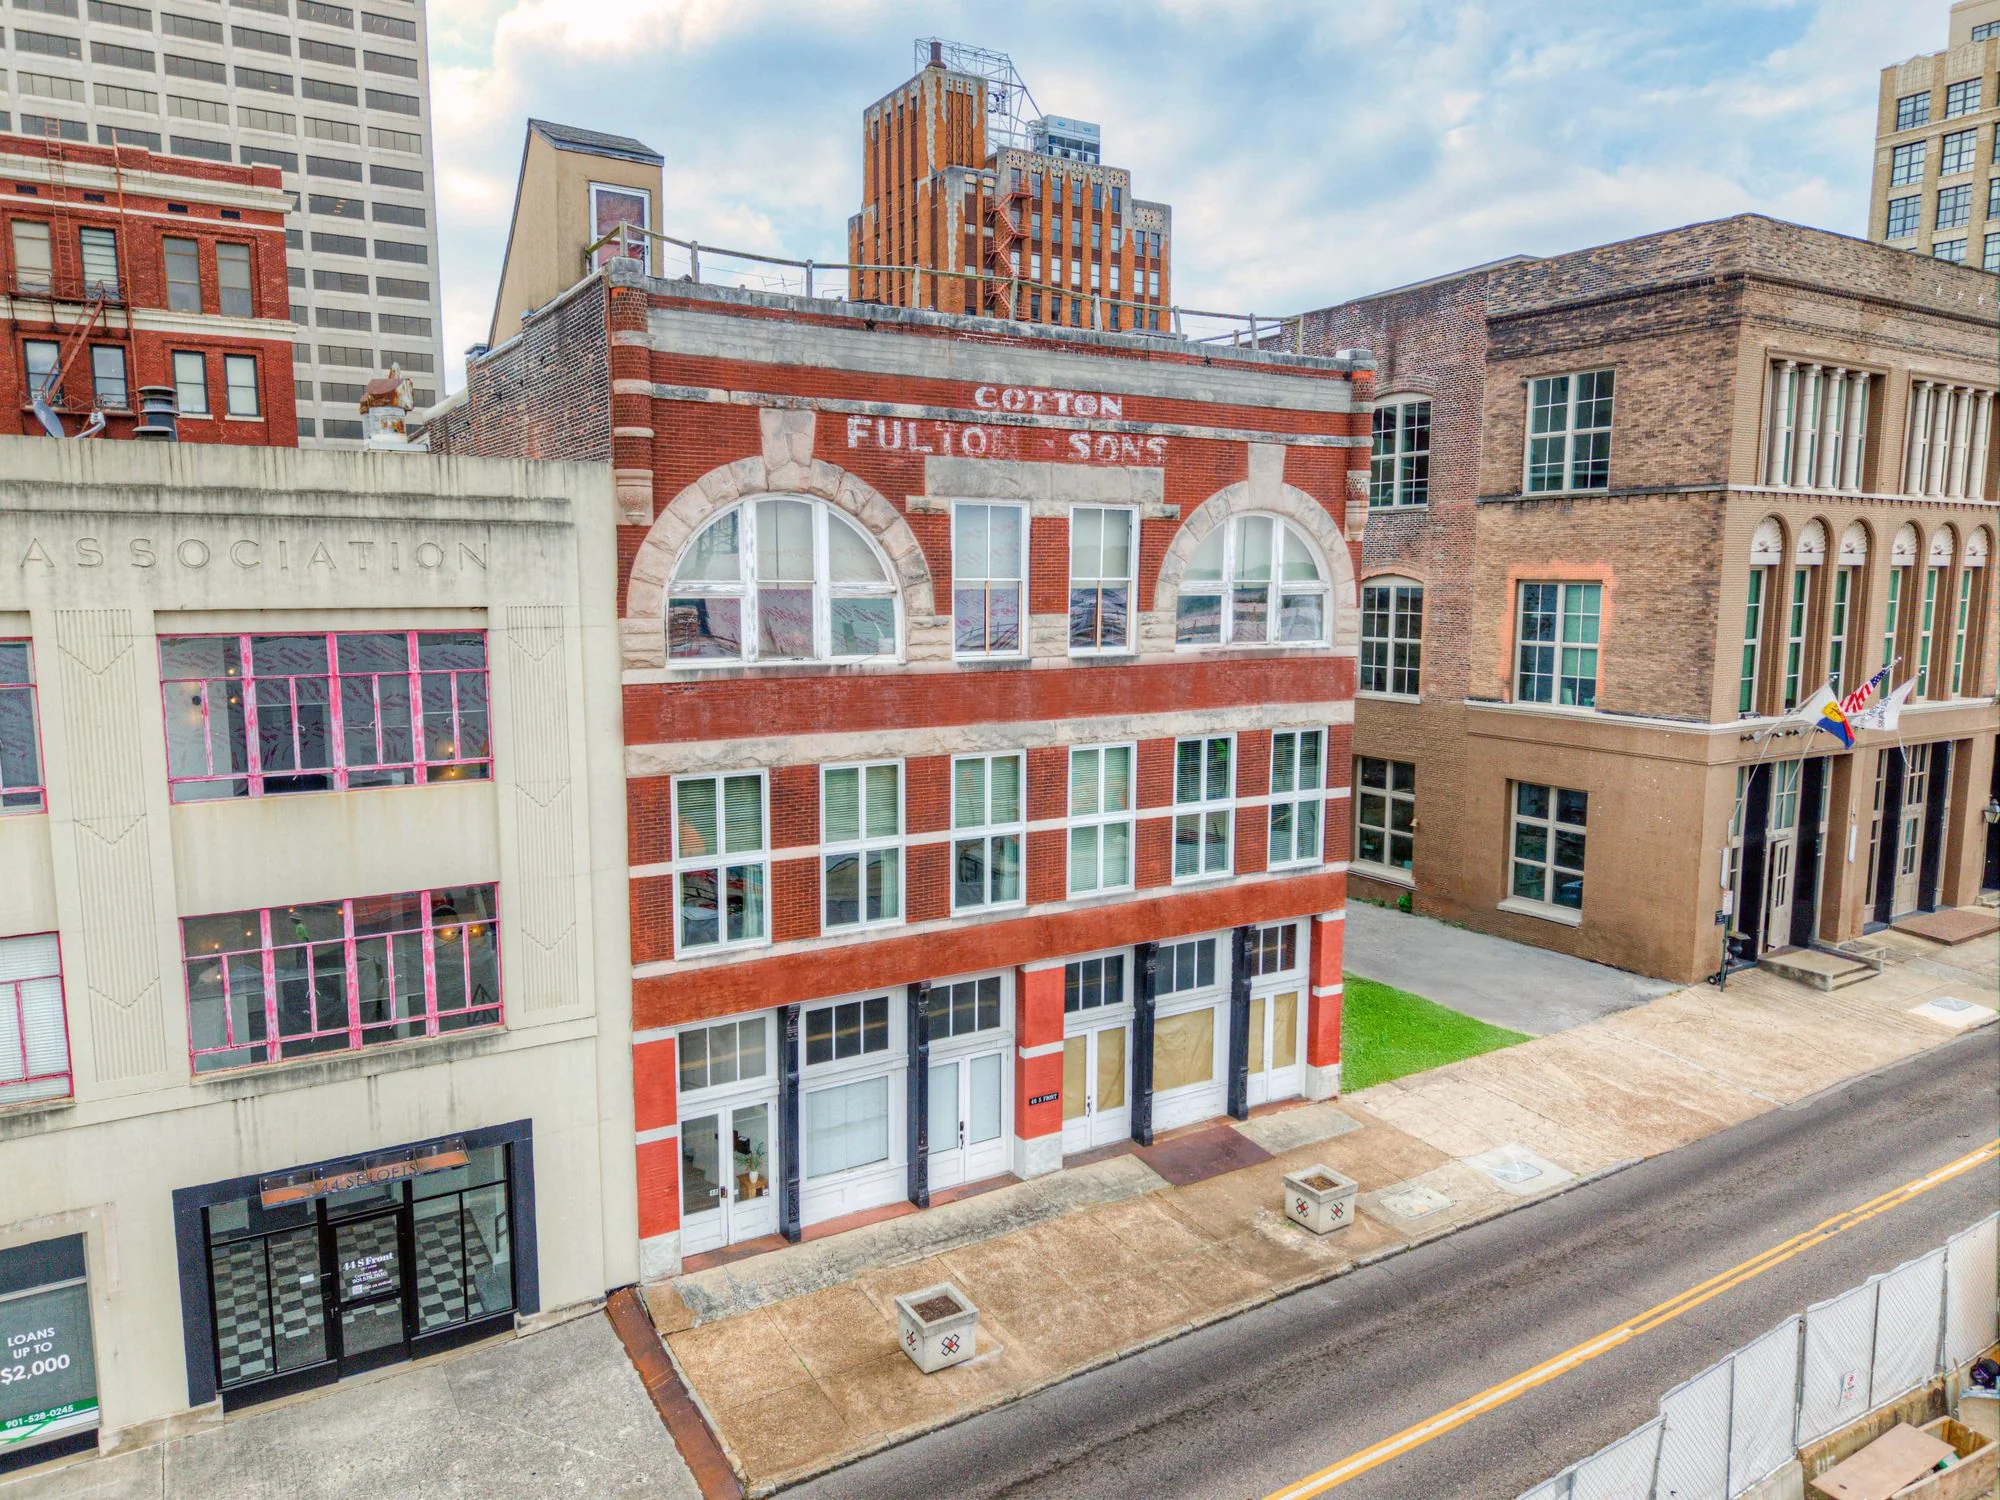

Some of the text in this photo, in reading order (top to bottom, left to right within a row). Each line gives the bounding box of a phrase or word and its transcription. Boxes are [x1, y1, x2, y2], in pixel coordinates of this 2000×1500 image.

[974, 386, 1122, 416] COTTON
[20, 537, 487, 571] ASSOCIATION
[320, 1179, 342, 1193] 44
[370, 1163, 417, 1184] LOFTS
[342, 1260, 356, 1271] 44
[357, 1258, 365, 1268] S
[365, 1252, 394, 1265] Front
[7, 1327, 56, 1347] LOANS
[13, 1341, 53, 1359] UP TO
[0, 1353, 71, 1386] $2,000
[5, 1404, 74, 1428] 901-528-0245
